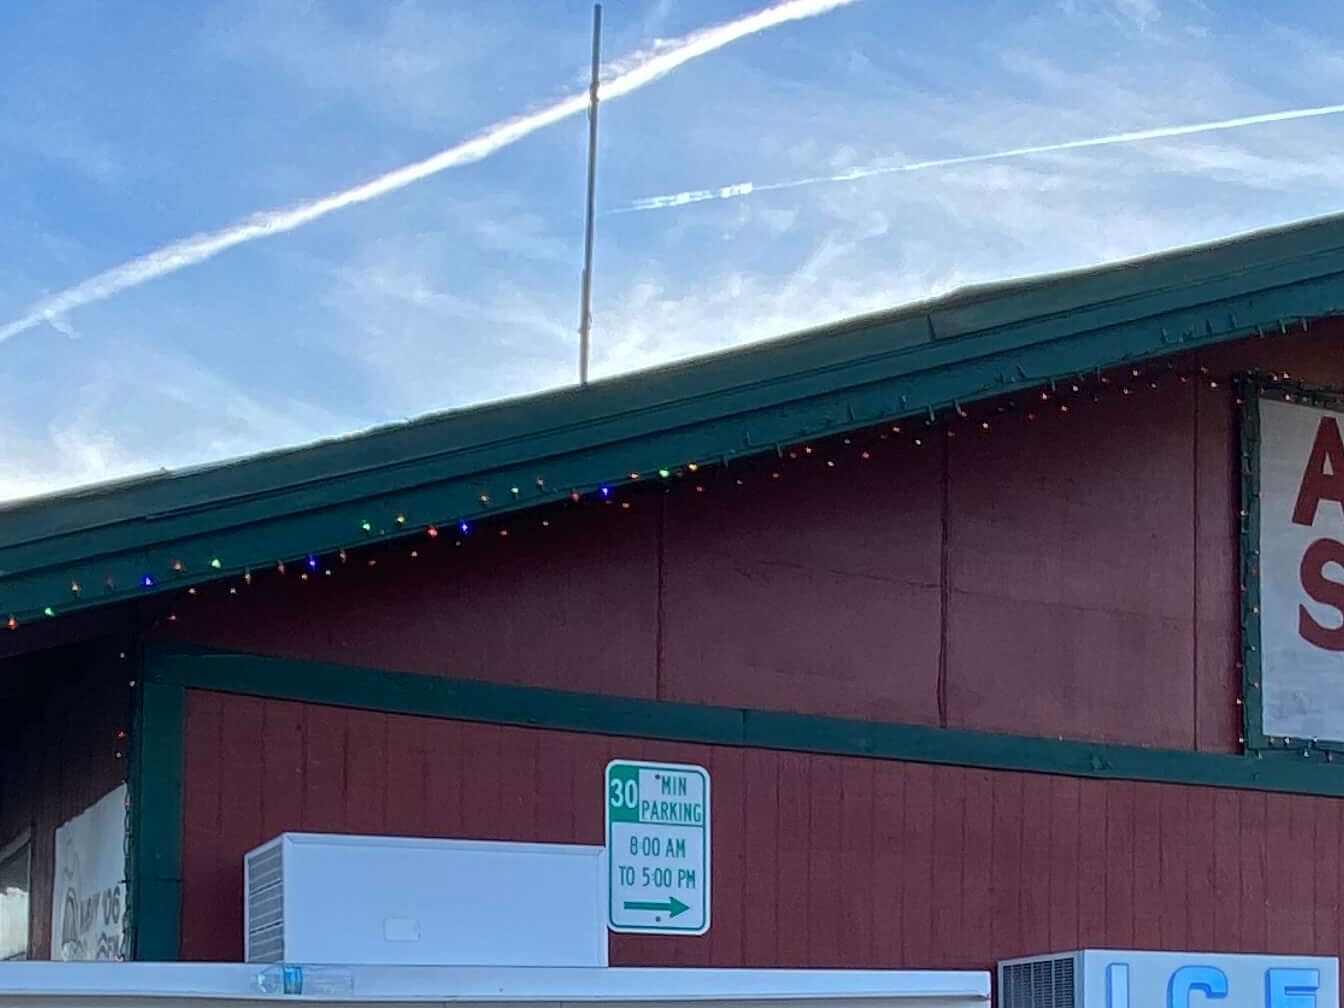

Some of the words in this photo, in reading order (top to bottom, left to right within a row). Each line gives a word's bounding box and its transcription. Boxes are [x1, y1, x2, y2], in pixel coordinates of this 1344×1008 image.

[610, 778, 638, 809] 30
[660, 775, 688, 797] MIN
[641, 799, 703, 823] PARKING
[630, 835, 661, 857] 8:00
[665, 838, 686, 859] AM
[618, 865, 636, 887] TO
[642, 866, 672, 888] 5:00
[677, 868, 696, 889] PM
